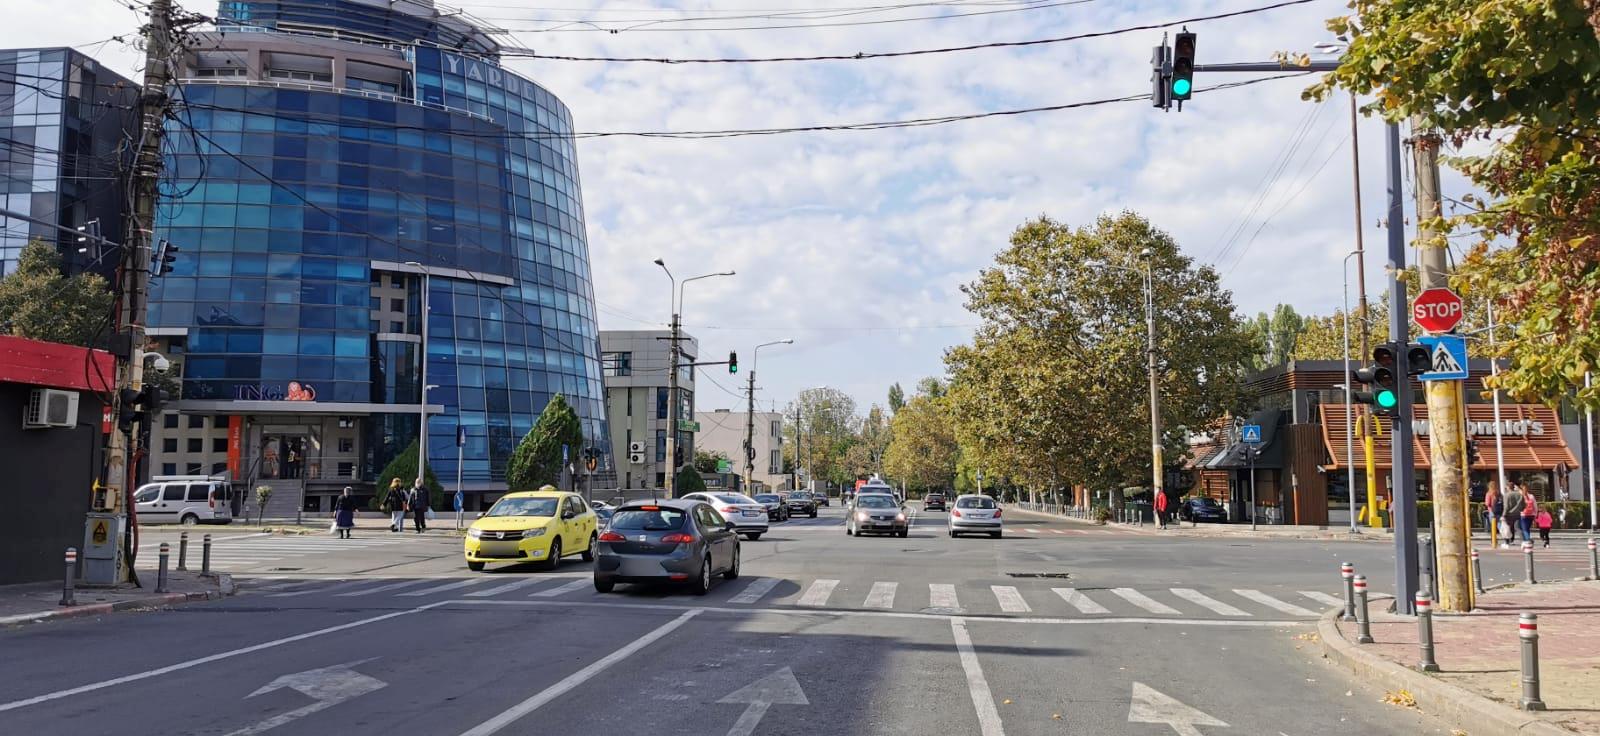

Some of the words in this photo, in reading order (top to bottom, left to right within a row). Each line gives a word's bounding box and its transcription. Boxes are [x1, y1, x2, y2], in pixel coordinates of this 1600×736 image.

[1415, 302, 1460, 318] STOP
[232, 384, 282, 401] ING
[1411, 419, 1544, 435] Monald's
